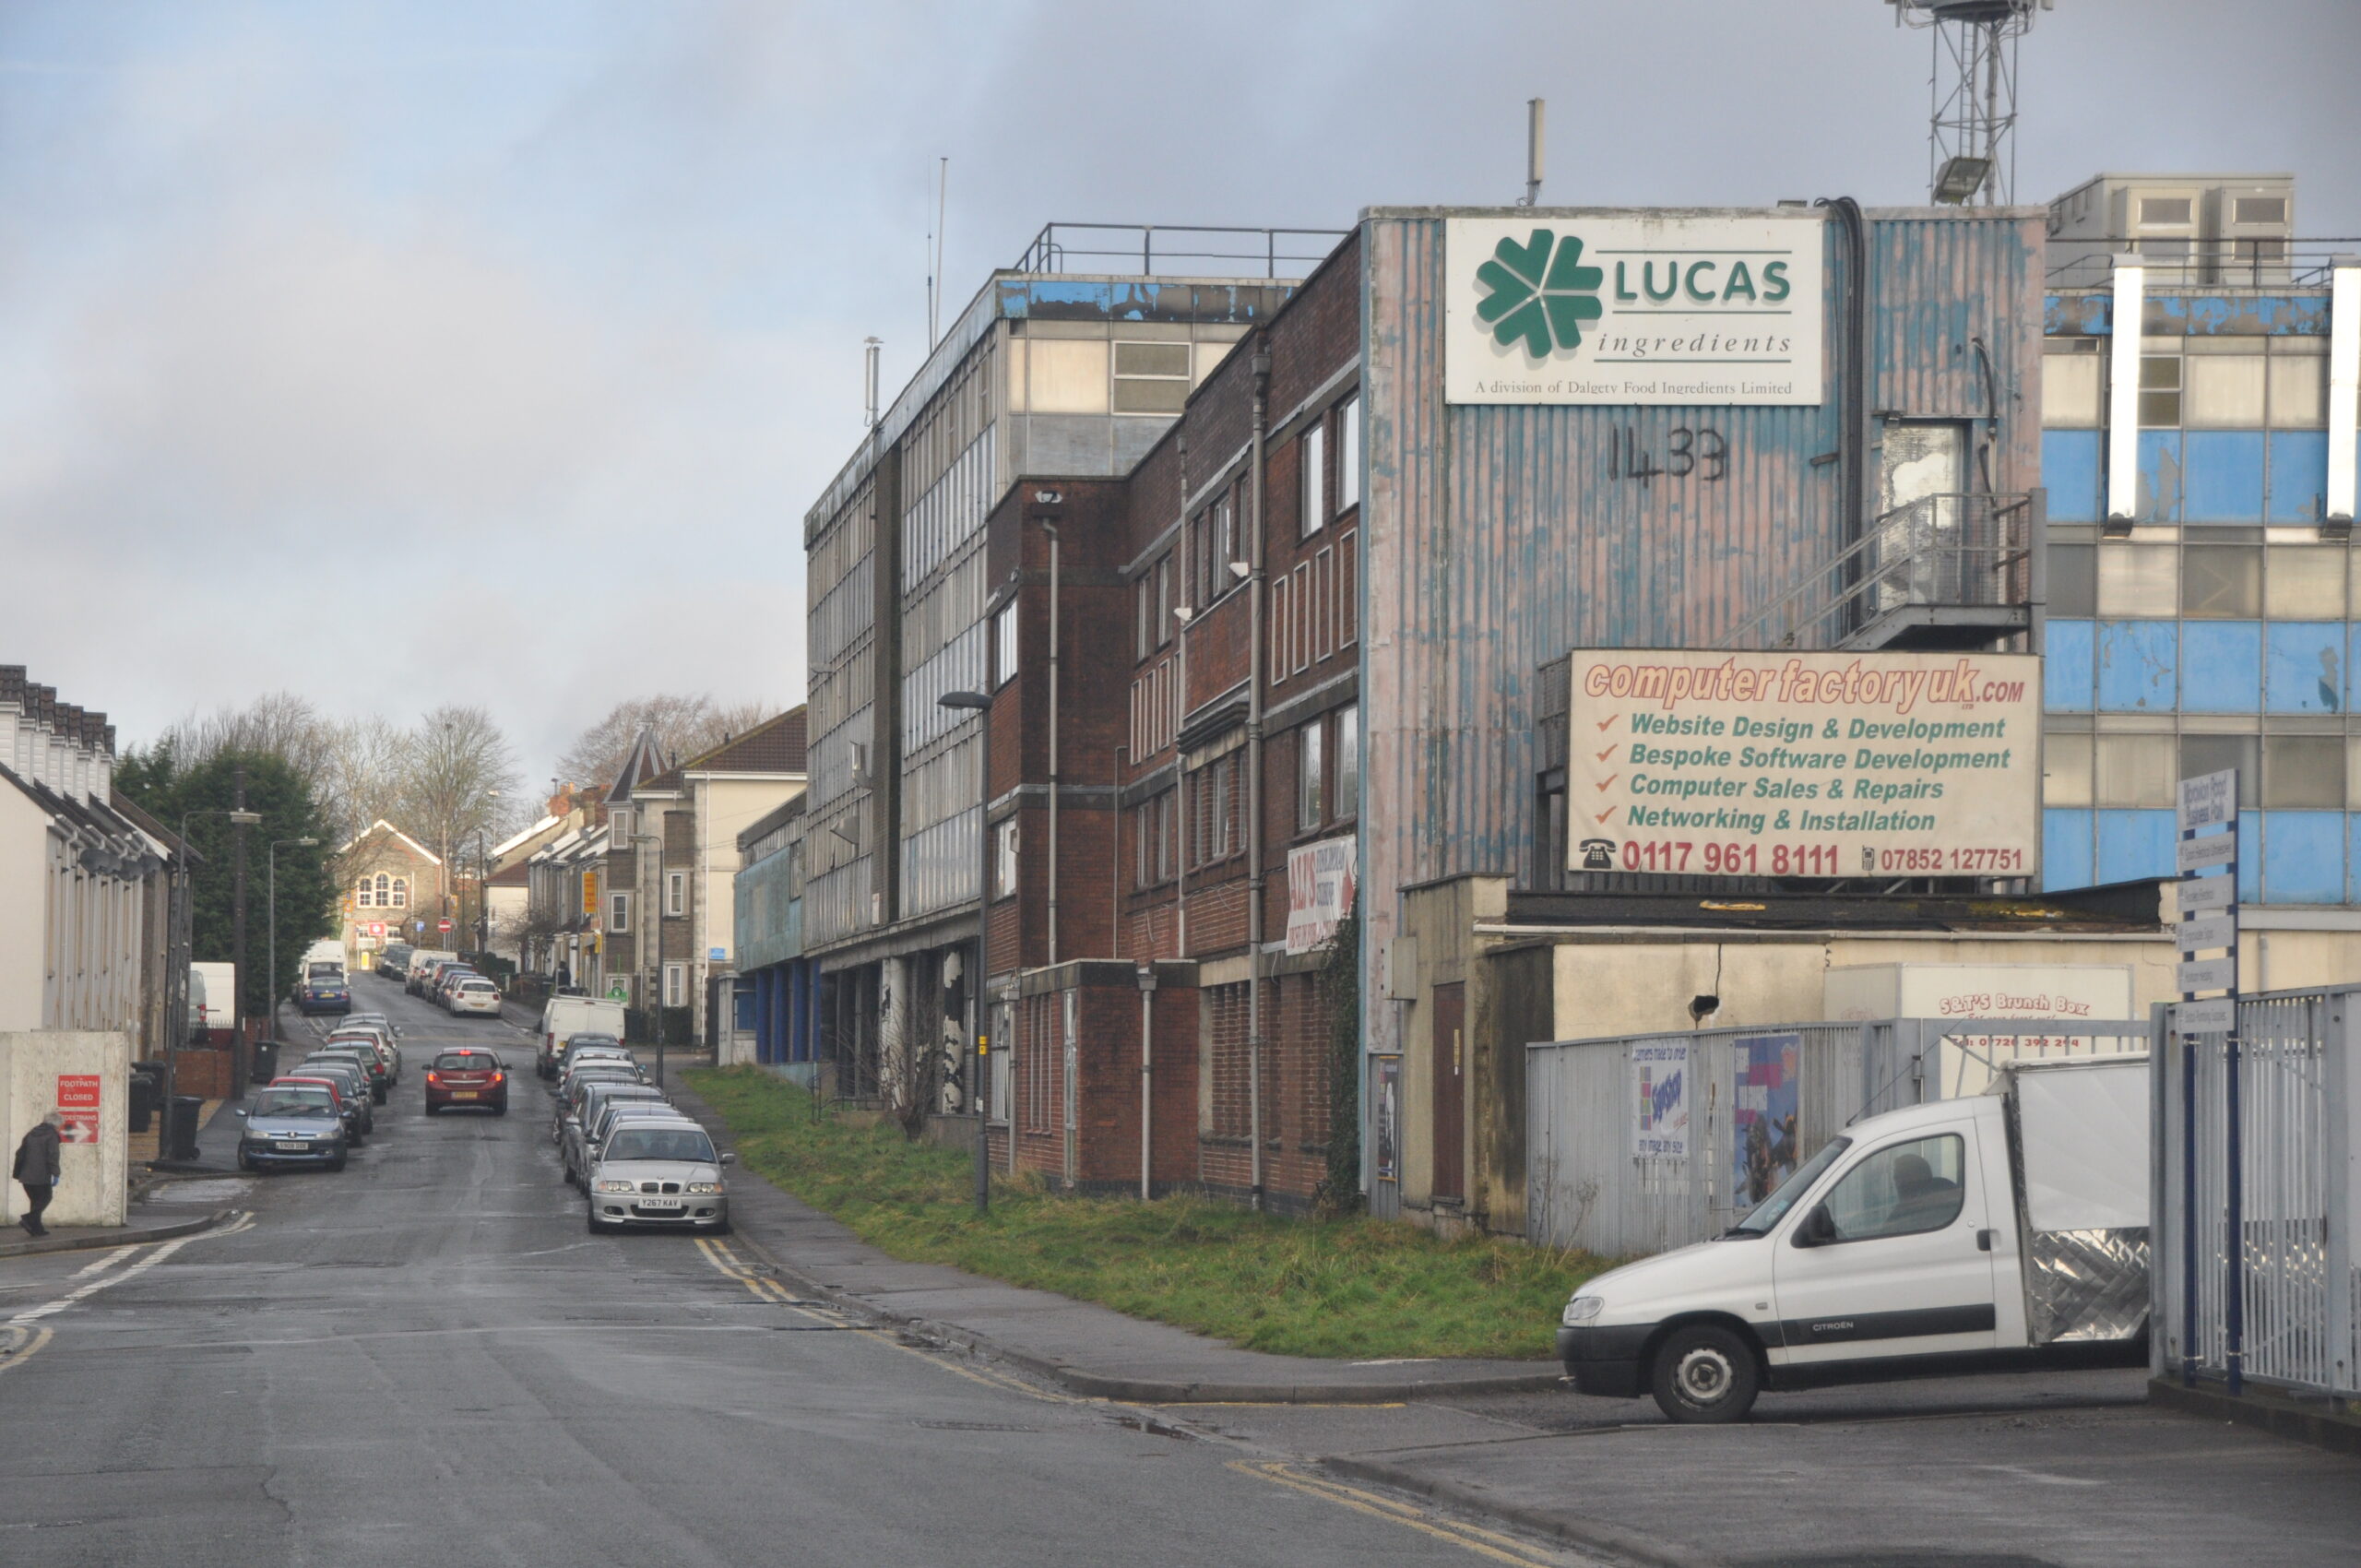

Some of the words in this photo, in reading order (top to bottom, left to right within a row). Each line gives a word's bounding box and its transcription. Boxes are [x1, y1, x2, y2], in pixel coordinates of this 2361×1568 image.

[1615, 260, 1791, 303] LUCAS
[1598, 333, 1791, 358] ingredients
[1476, 381, 1485, 395] A
[1490, 380, 1542, 394] division
[1548, 380, 1562, 394] of
[1568, 380, 1618, 395] Dalgety
[1624, 380, 1656, 394] Food
[1662, 380, 1736, 395] Ingredients
[1741, 380, 1792, 395] Limited
[1630, 713, 1725, 736] Website
[1731, 717, 1813, 743] Design
[1821, 719, 1840, 739] &
[1847, 719, 2006, 743] Development
[1629, 744, 1732, 770] Bespoke
[1738, 746, 1846, 769] Software
[1854, 747, 2011, 773] Development
[1630, 774, 1747, 801] Computer
[1753, 778, 1819, 800] Sales
[1827, 779, 1844, 800] &
[1853, 778, 1944, 803] Repairs
[1627, 806, 1766, 835] Networking
[1774, 810, 1791, 830] &
[1798, 809, 1935, 831] Installation
[1622, 840, 1692, 871] 0117
[1703, 843, 1758, 873] 961
[1771, 845, 1838, 874] 8111
[1880, 849, 1943, 871] 07852
[1950, 849, 2023, 871] 127751
[1996, 994, 2049, 1011] Brunch
[2055, 996, 2090, 1016] Box
[64, 1093, 93, 1101] CLOSED
